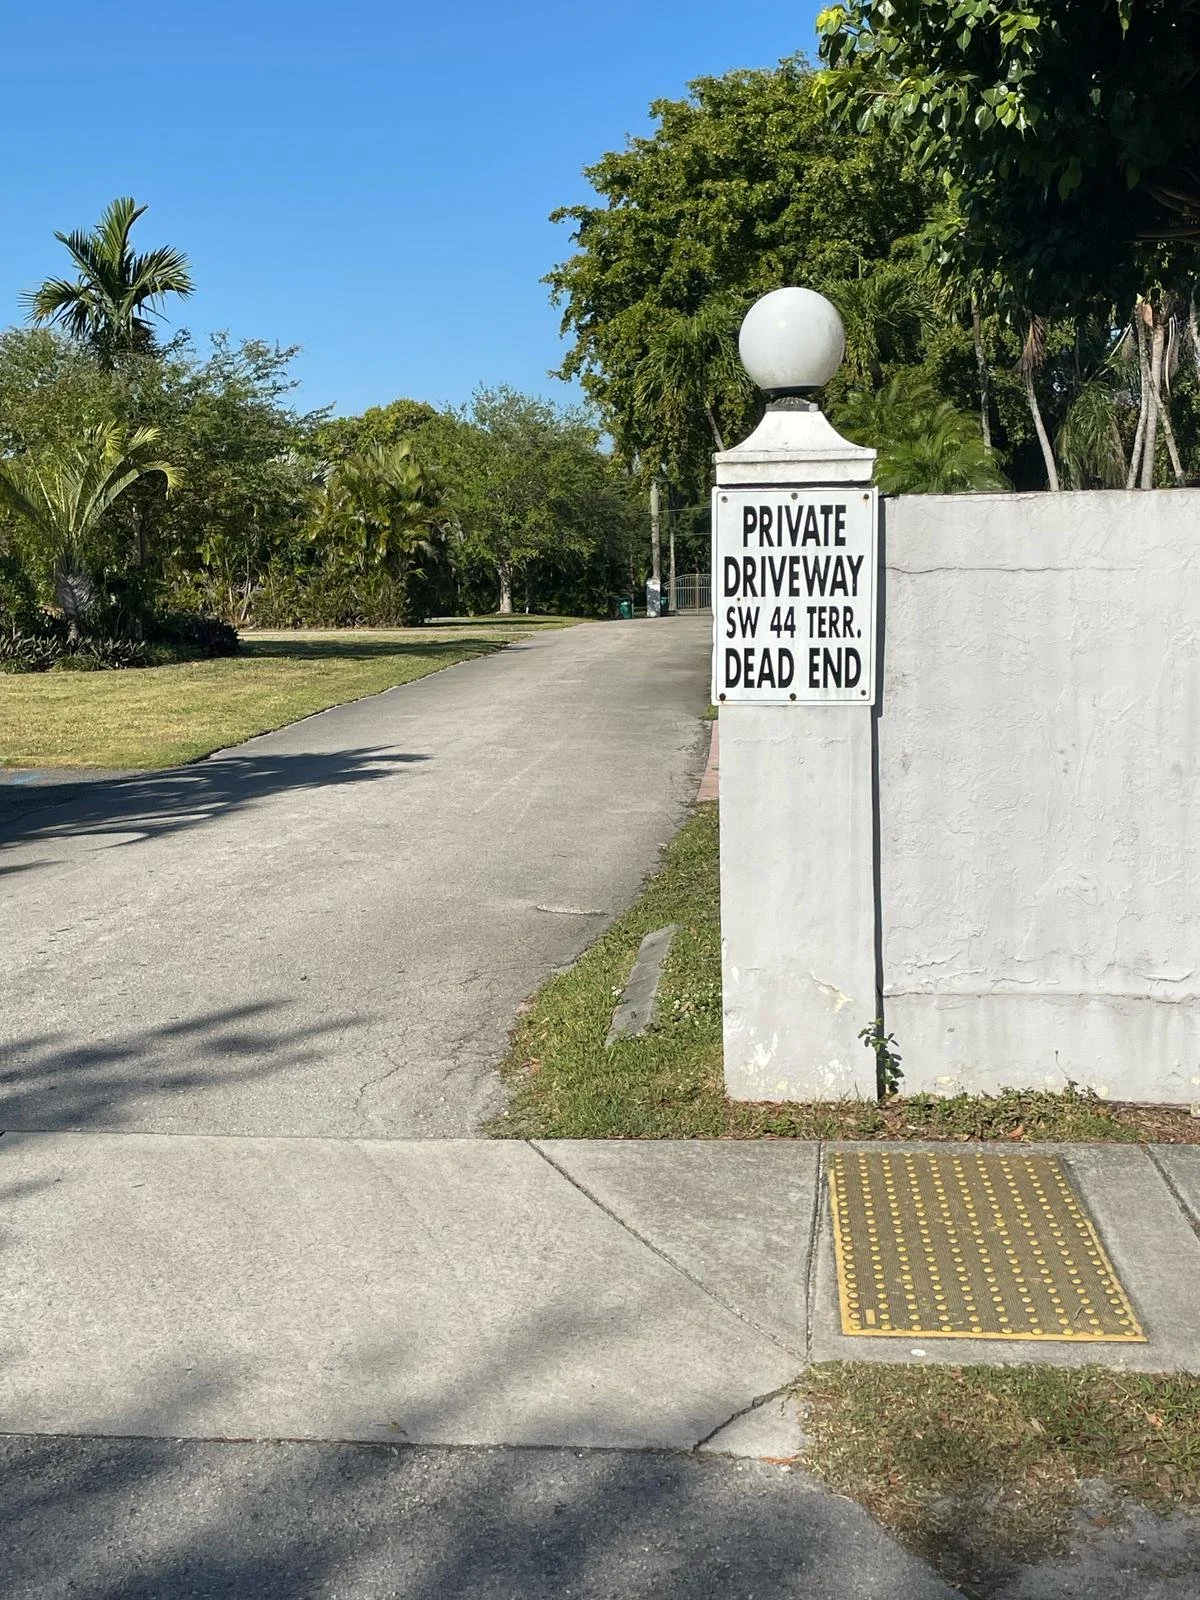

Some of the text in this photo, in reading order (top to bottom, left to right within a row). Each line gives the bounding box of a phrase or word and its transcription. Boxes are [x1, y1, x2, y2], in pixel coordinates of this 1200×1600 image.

[743, 504, 847, 547] PRIVATE
[724, 555, 864, 597] DRIVEWAY
[726, 606, 862, 638] SW 44 TERR.
[725, 647, 862, 688] DEAD END
